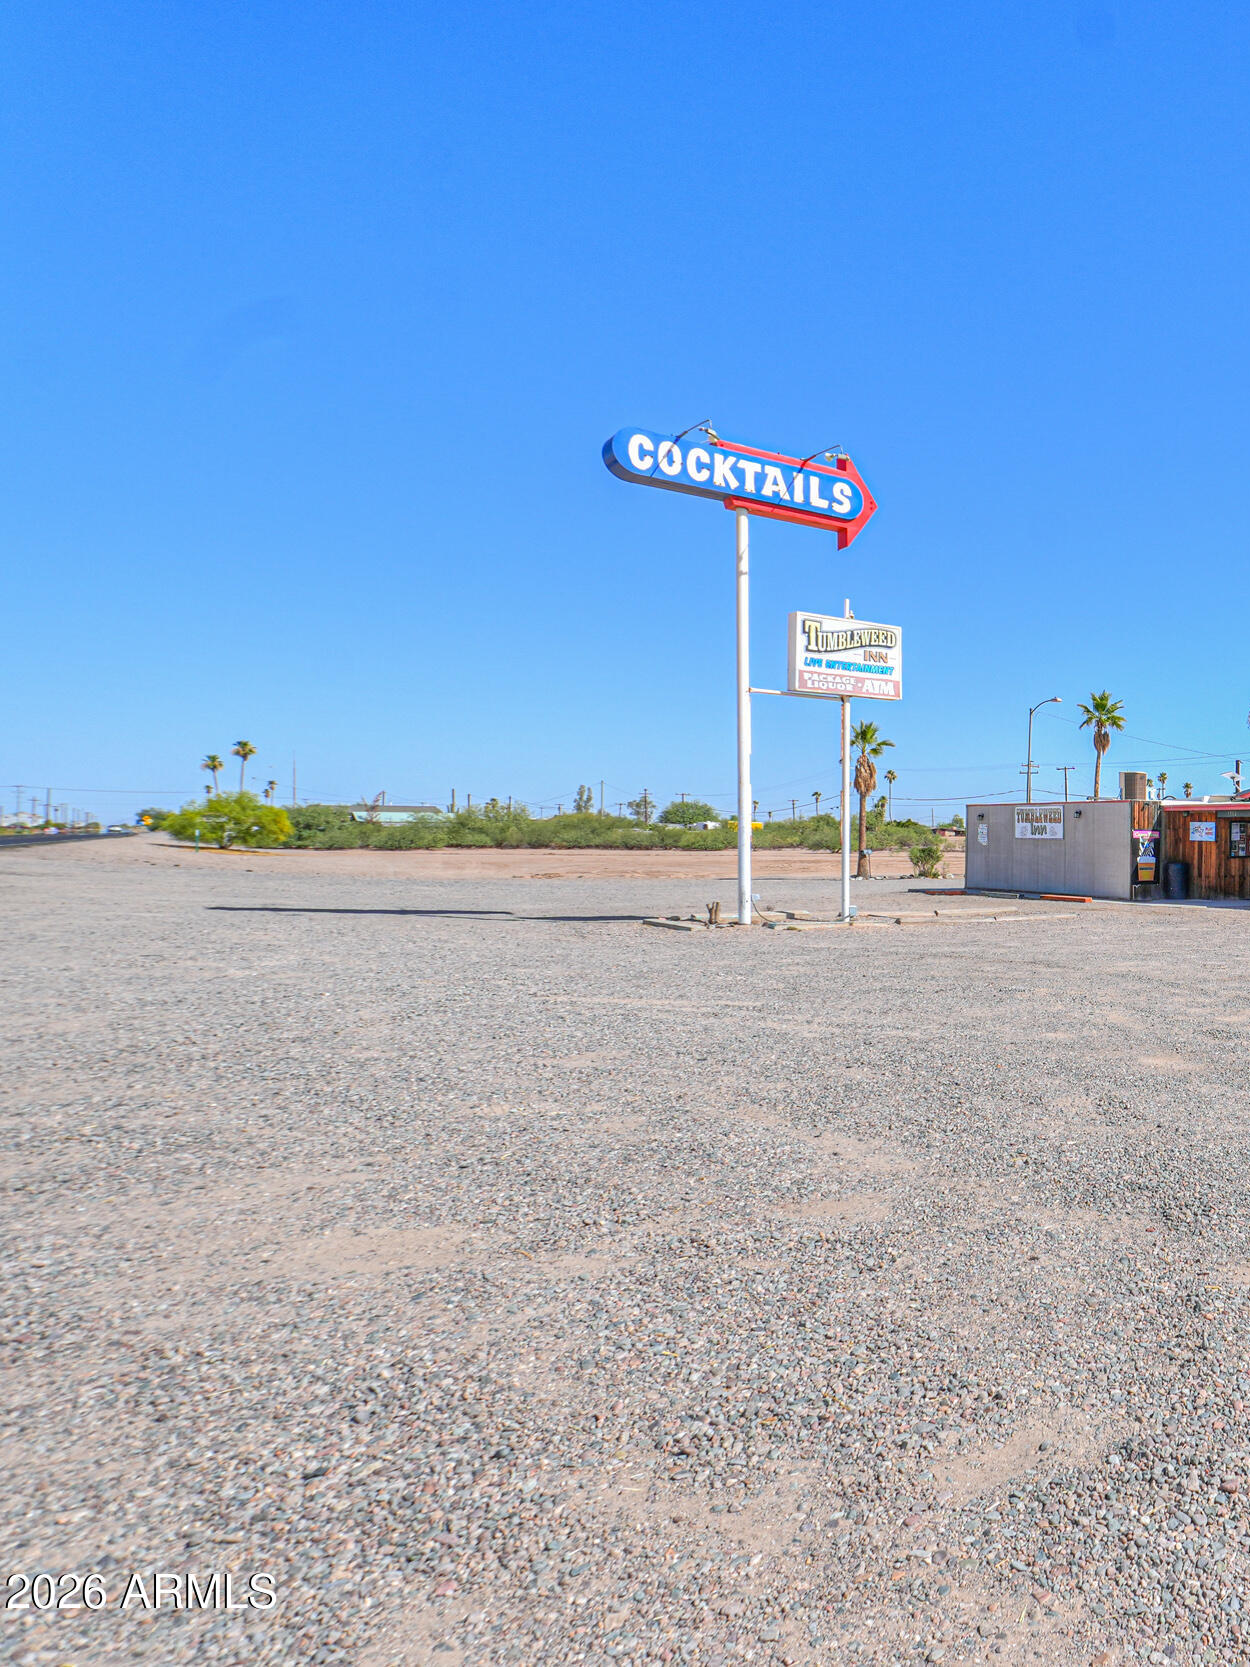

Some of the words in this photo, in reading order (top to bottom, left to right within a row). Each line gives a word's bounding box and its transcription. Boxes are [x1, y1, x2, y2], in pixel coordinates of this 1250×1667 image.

[627, 433, 853, 514] COCKTAILS
[803, 619, 897, 653] TUMBLEWEED
[863, 650, 889, 664] INN
[804, 657, 823, 668] LIVE
[825, 659, 895, 676] ENTERTAINMENT
[803, 672, 857, 685] PACKAGE
[806, 679, 854, 692] LIQUOR
[862, 679, 896, 696] ATM
